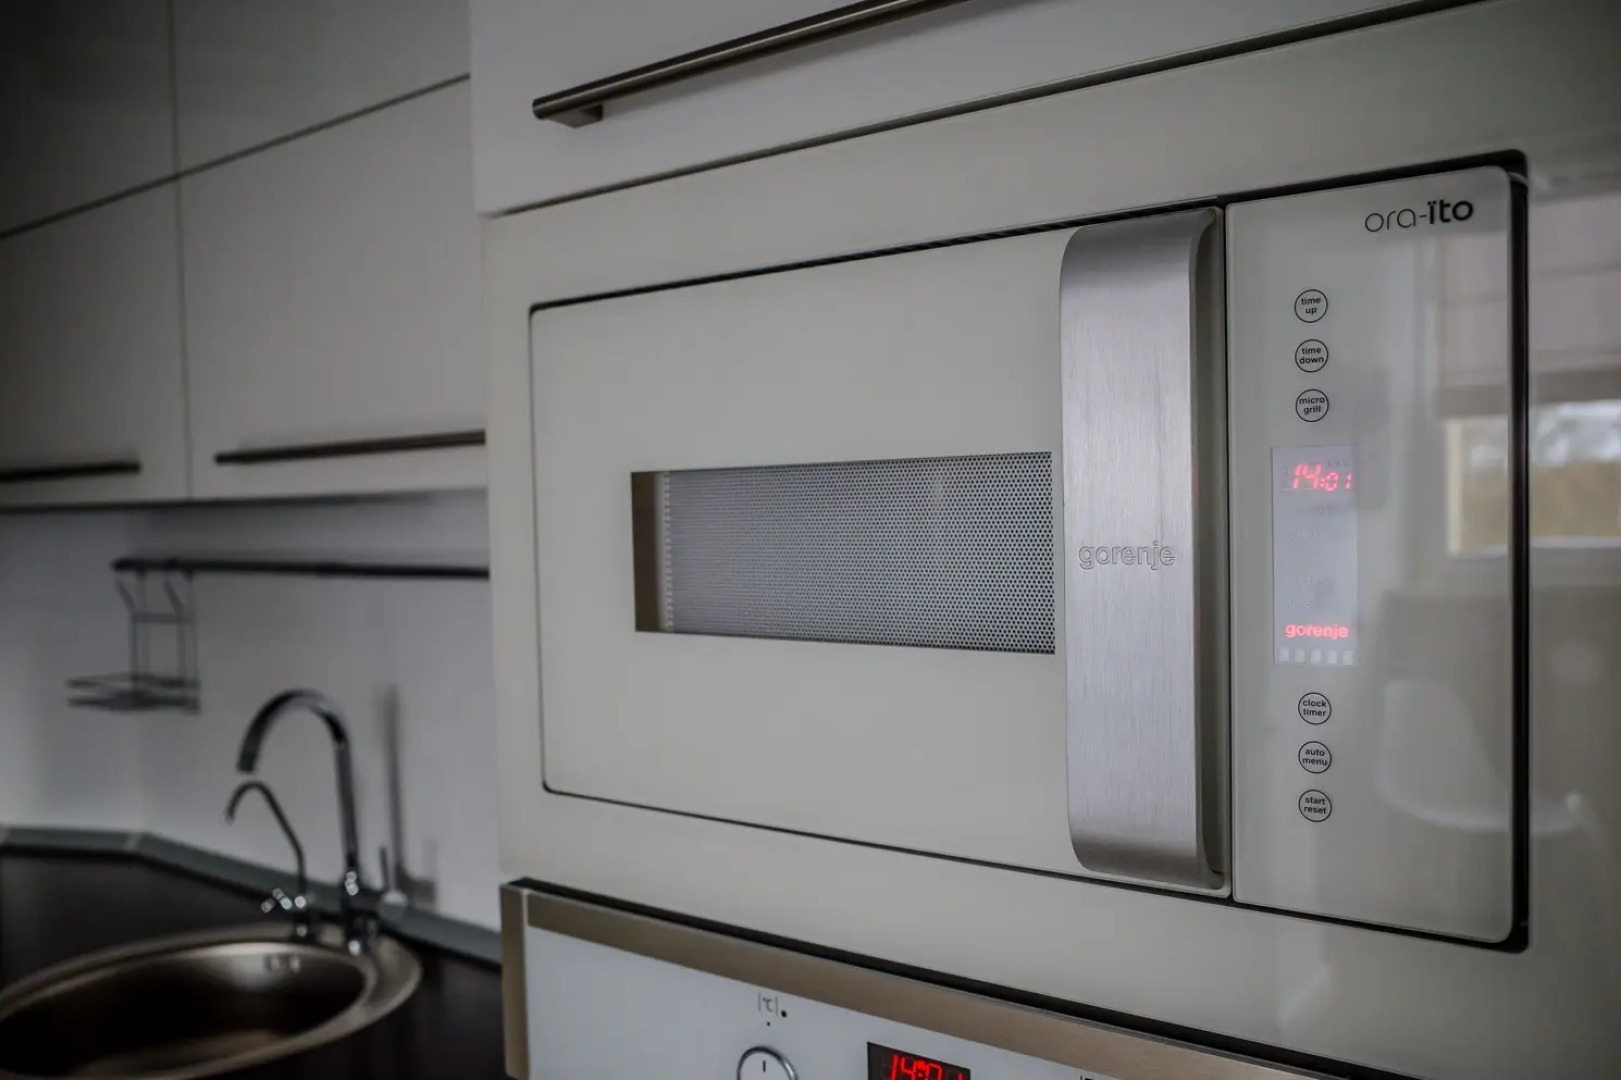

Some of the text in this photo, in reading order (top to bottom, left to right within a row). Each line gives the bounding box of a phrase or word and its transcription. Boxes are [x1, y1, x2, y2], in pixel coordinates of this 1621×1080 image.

[1364, 199, 1474, 233] ora-ïto
[1301, 296, 1321, 304] time
[1305, 306, 1317, 315] up
[1301, 346, 1322, 355] time
[1299, 355, 1325, 364] down
[1299, 396, 1325, 405] micro
[1303, 405, 1322, 415] grill
[1292, 463, 1352, 491] 14:01
[1078, 540, 1176, 570] gorenje
[1285, 622, 1350, 641] gorenje
[1302, 699, 1327, 708] clock
[1302, 708, 1326, 717] timer
[1302, 757, 1328, 766] menu
[1305, 797, 1325, 805] start
[1304, 806, 1327, 814] reset
[890, 1053, 964, 1080] 14:0
